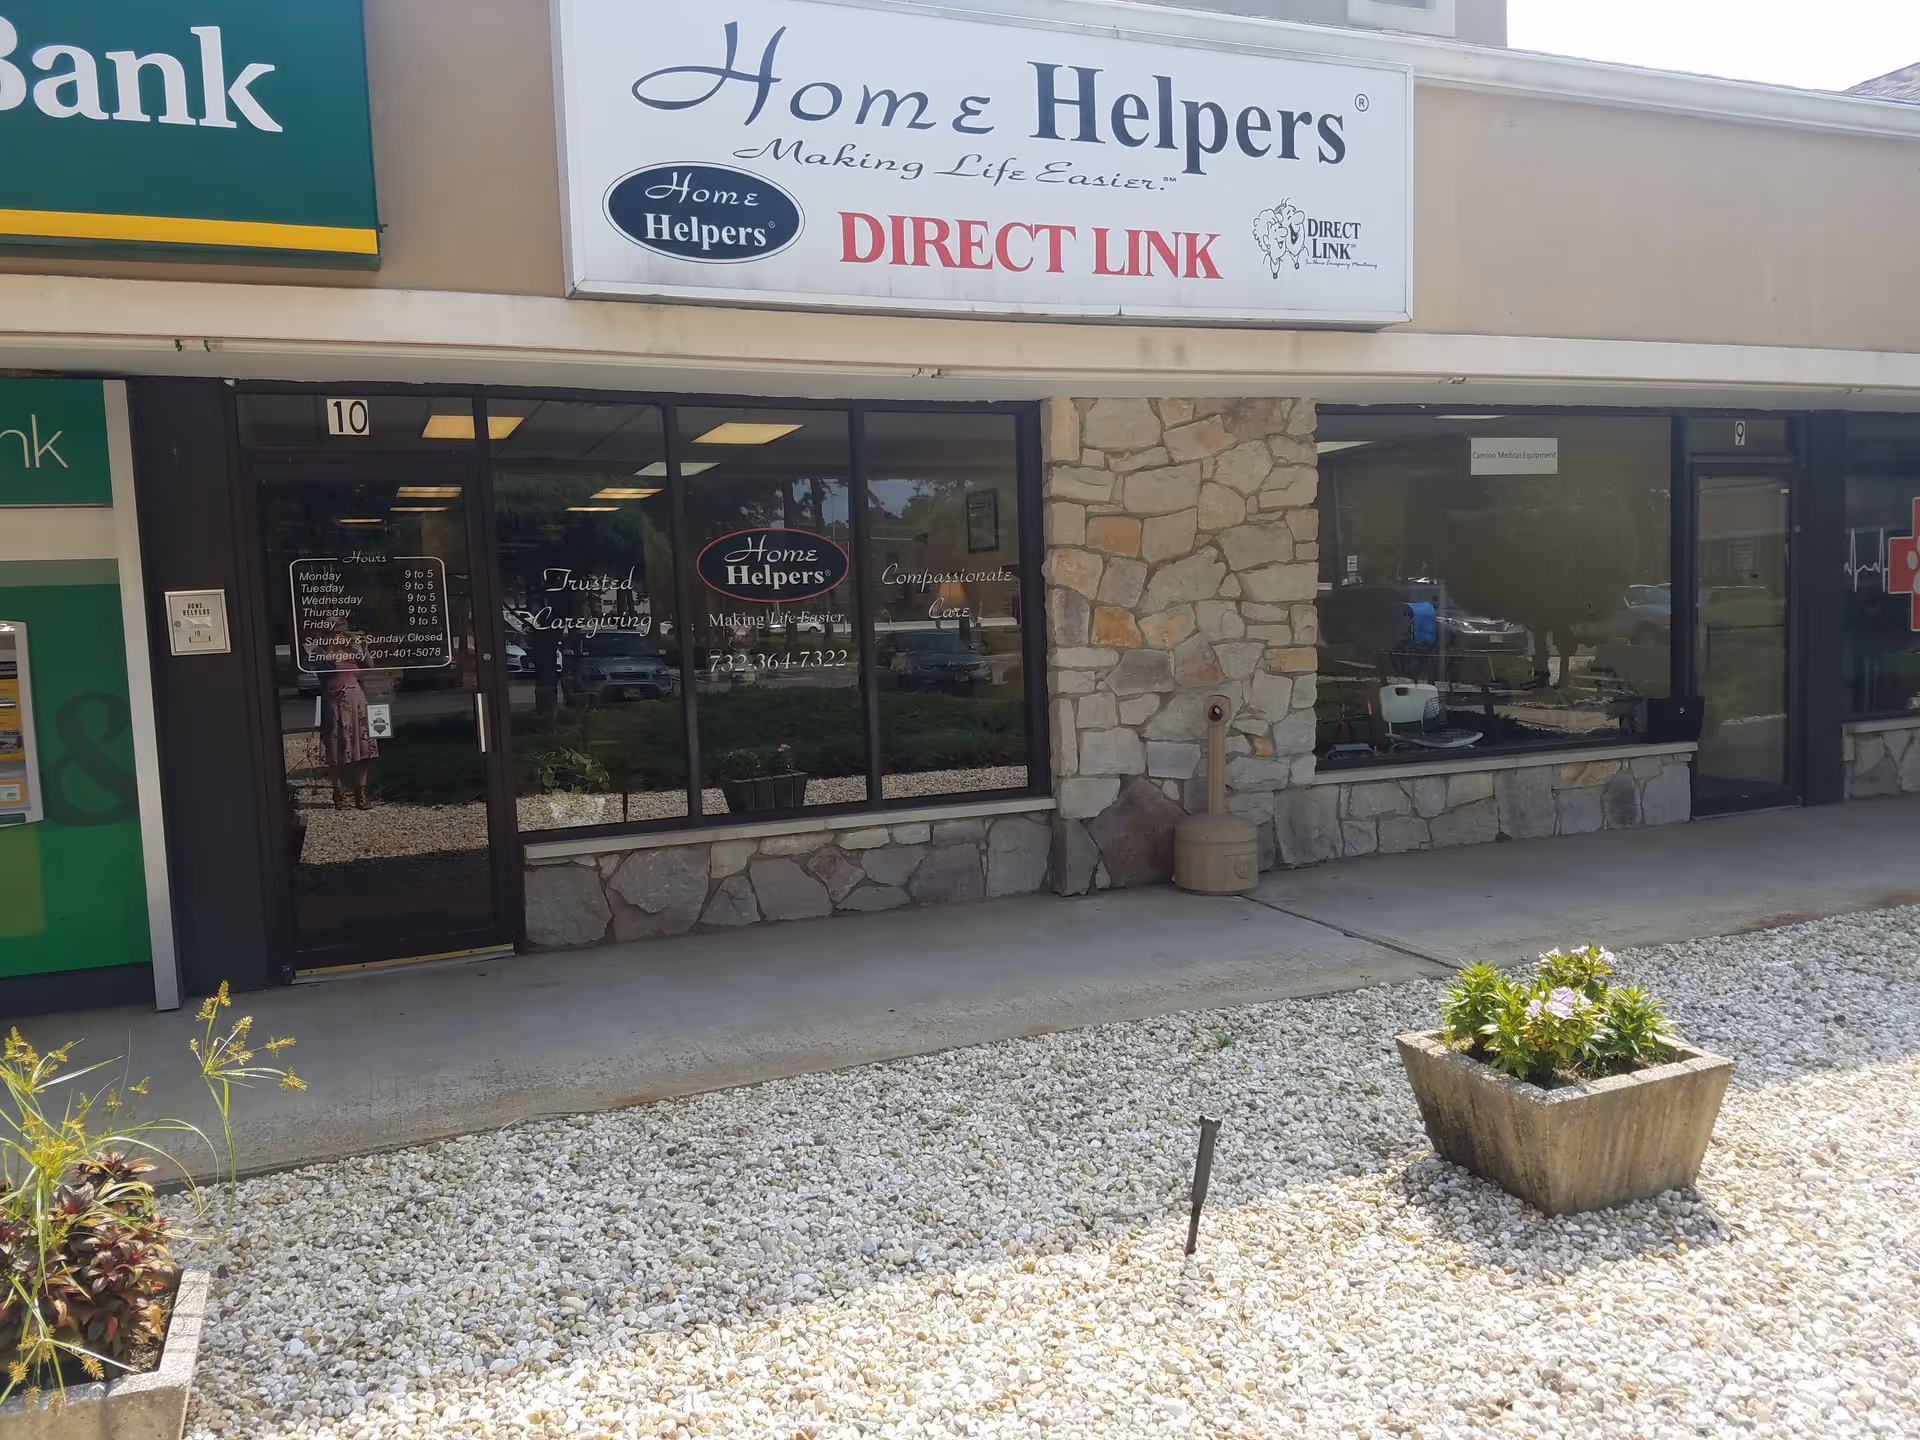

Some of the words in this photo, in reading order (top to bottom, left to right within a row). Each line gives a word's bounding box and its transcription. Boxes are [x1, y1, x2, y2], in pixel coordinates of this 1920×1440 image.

[631, 21, 995, 134] Home
[1027, 60, 1347, 175] Helpers
[733, 138, 924, 180] Making
[932, 153, 1027, 187] Life
[645, 171, 761, 207] Home
[643, 212, 767, 250] Helpers
[1307, 218, 1361, 240] DIRECT
[838, 211, 1077, 274] DIRECT
[1092, 226, 1224, 281] LINK
[1312, 238, 1351, 260] LINK
[333, 400, 368, 434] 10
[1736, 421, 1746, 446] 9
[1472, 451, 1497, 460] Camino
[1497, 451, 1522, 460] Medical
[1522, 451, 1557, 461] Equipment
[343, 550, 388, 564] Hours
[724, 534, 819, 563] Home
[299, 571, 342, 583] Monday
[404, 570, 412, 579] 9
[414, 570, 424, 579] to
[427, 570, 434, 579] 5
[301, 584, 345, 594] Tuesday
[404, 581, 412, 591] 9
[413, 581, 424, 590] to
[427, 581, 434, 590] 5
[543, 566, 636, 592] Trusted
[725, 564, 825, 590] Helpers
[881, 563, 1013, 593] Compassionate
[301, 595, 363, 606] Wednesday
[407, 593, 414, 602] 9
[416, 593, 427, 602] to
[429, 593, 436, 601] 5
[302, 608, 352, 618] Thursday
[408, 605, 415, 614] 9
[417, 605, 428, 613] to
[430, 604, 437, 613] 5
[928, 598, 970, 619] Care
[303, 620, 336, 630] Friday
[409, 617, 416, 625] 9
[418, 617, 429, 625] to
[431, 616, 438, 625] 5
[532, 606, 652, 638] Caregiving
[708, 612, 765, 629] Making
[770, 610, 797, 625] Life
[800, 611, 845, 624] Easier
[304, 635, 352, 646] Saturday
[355, 634, 363, 644] &
[365, 634, 405, 645] Sunday
[407, 632, 443, 642] Closed
[308, 650, 368, 662] Emergency
[370, 647, 441, 659] 201-401-5078
[709, 649, 848, 673] 732-364-7322
